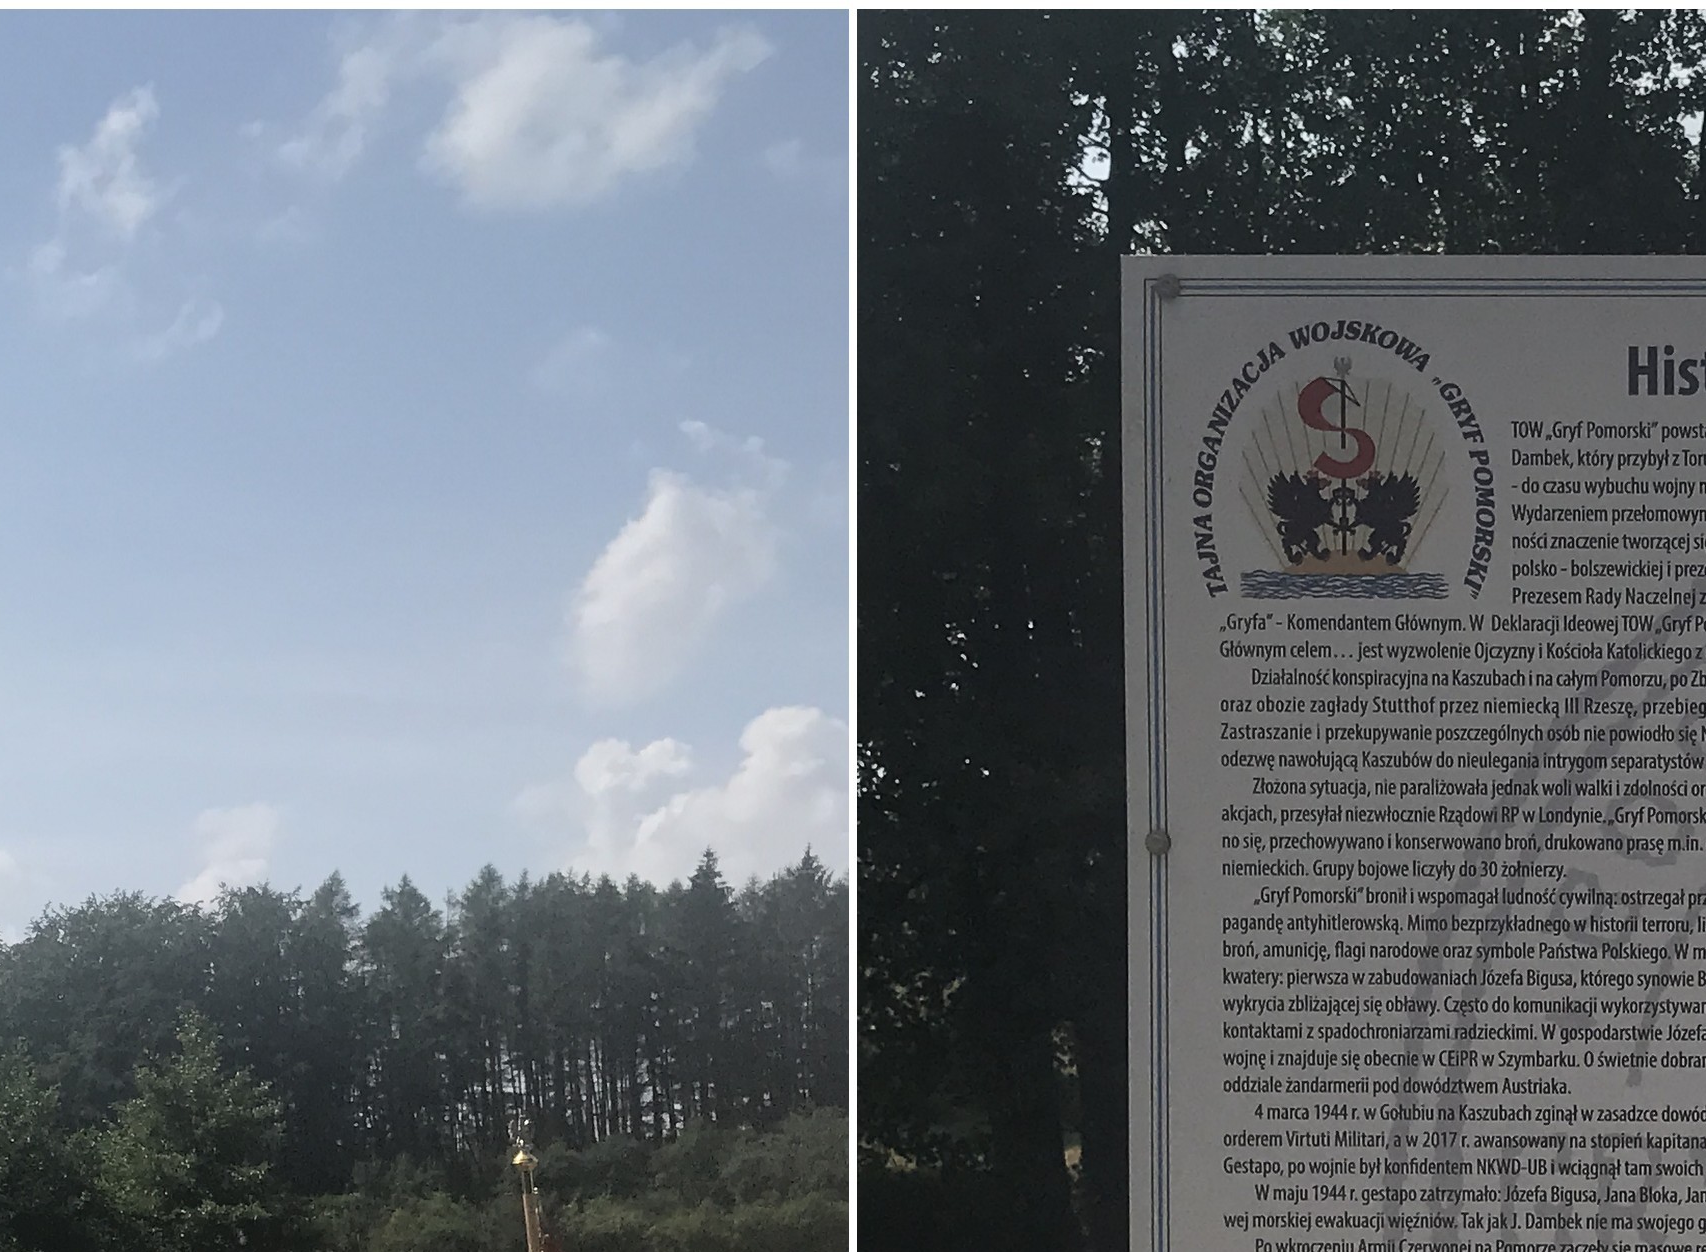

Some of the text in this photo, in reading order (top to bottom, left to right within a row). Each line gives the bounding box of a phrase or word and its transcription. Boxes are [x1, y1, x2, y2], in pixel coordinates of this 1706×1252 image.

[1288, 320, 1431, 373] WOJSKOWA
[1193, 341, 1287, 509] ORGANIZACJA
[1510, 419, 1544, 439] TOW
[1193, 513, 1229, 598] TAJNA
[1220, 698, 1252, 713] oraz
[1256, 694, 1306, 713] obozie
[1309, 694, 1369, 718] zagłady
[1371, 694, 1436, 714] Stutthof
[1438, 700, 1479, 718] przez
[1482, 695, 1560, 719] niemiecką
[1564, 696, 1579, 714] III
[1583, 696, 1638, 719] Rzeszę,
[1220, 749, 1275, 771] odezwę
[1278, 749, 1358, 772] nawołującą
[1361, 749, 1433, 768] Kaszubów
[1435, 750, 1454, 768] do
[1456, 750, 1539, 773] nieulegania
[1542, 751, 1608, 774] intrygom
[1610, 751, 1705, 774] separatystów
[1221, 857, 1567, 882] niemieckich. Grupy bojowe liczyły do 30 żołnierzy.
[1222, 1074, 1572, 1097] oddziale żandarmerii pod dowództwem Austriaka.
[1222, 1156, 1284, 1178] Gestapo,
[1287, 1161, 1306, 1178] po
[1308, 1157, 1356, 1179] wojnie
[1358, 1156, 1382, 1179] był
[1383, 1156, 1473, 1175] konfidentem
[1476, 1157, 1548, 1176] NKWD-UB
[1550, 1158, 1555, 1175] i
[1557, 1157, 1622, 1180] wciągnął
[1623, 1160, 1652, 1176] tam
[1654, 1158, 1704, 1177] swoich
